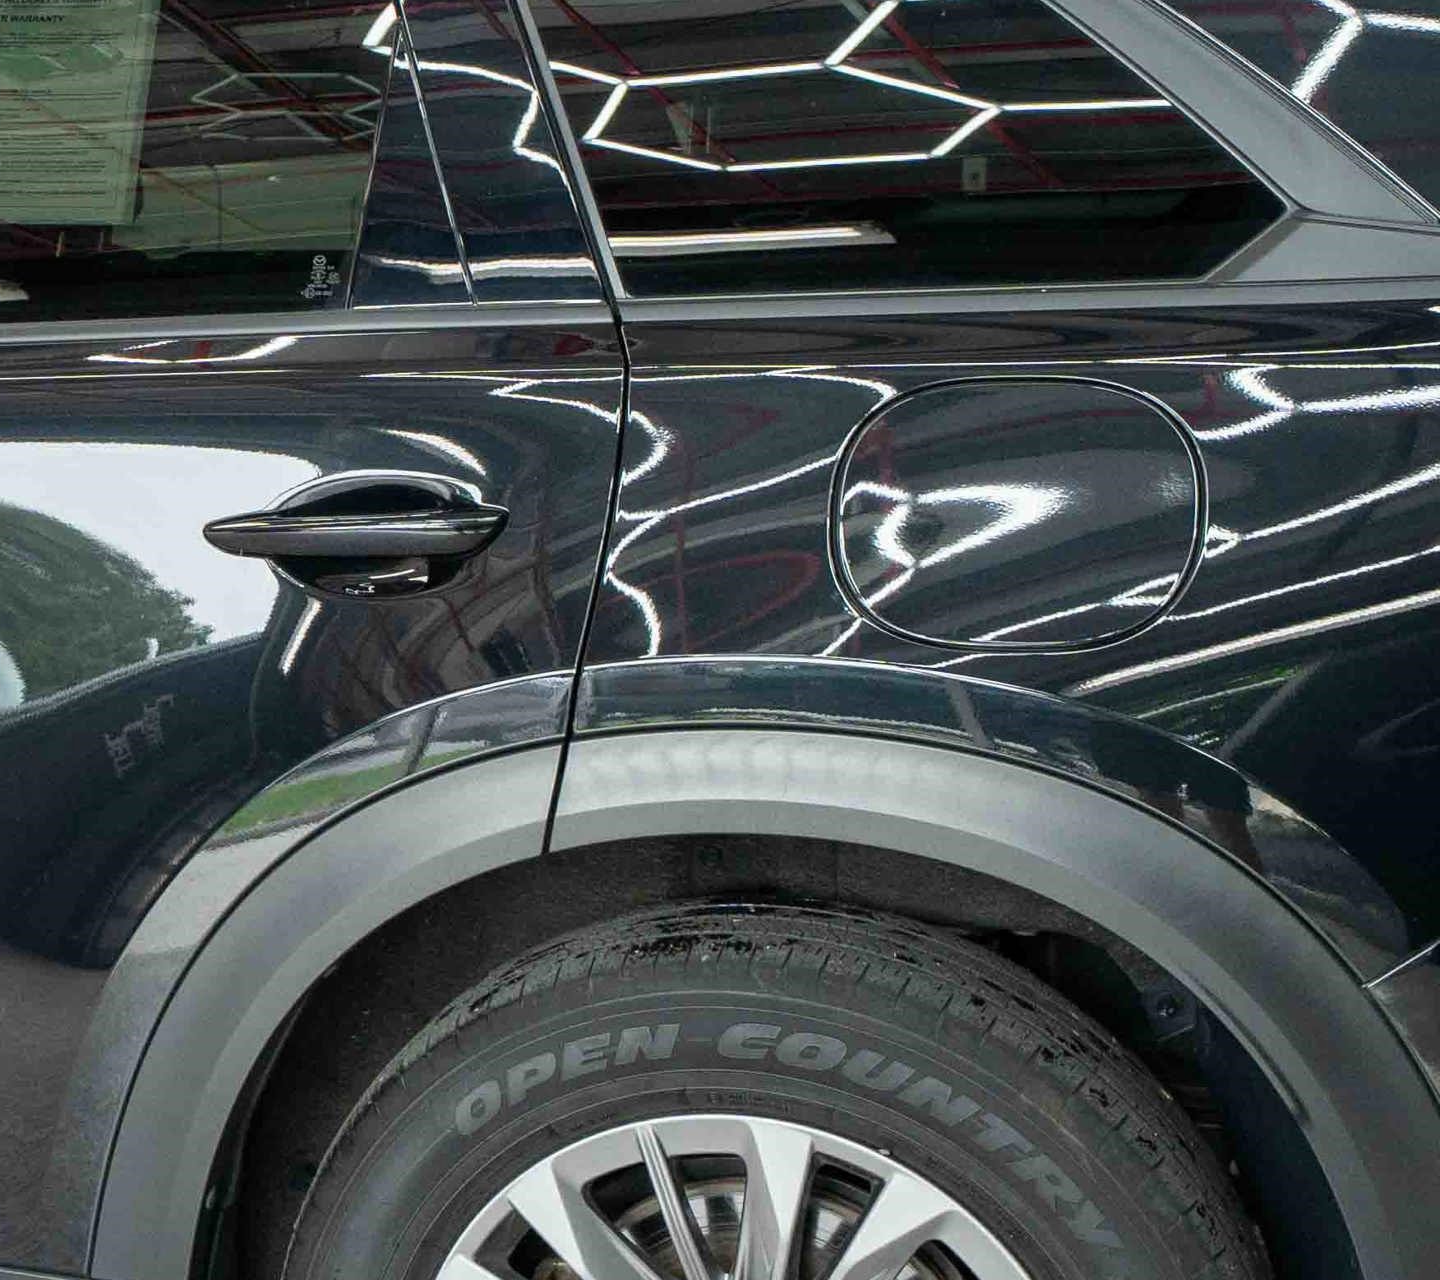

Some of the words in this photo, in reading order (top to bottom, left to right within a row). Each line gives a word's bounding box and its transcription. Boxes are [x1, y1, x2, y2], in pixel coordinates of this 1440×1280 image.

[10, 14, 65, 24] WARRANTY
[452, 1023, 681, 1135] OPEN
[718, 1022, 1118, 1250] COUNTRY
